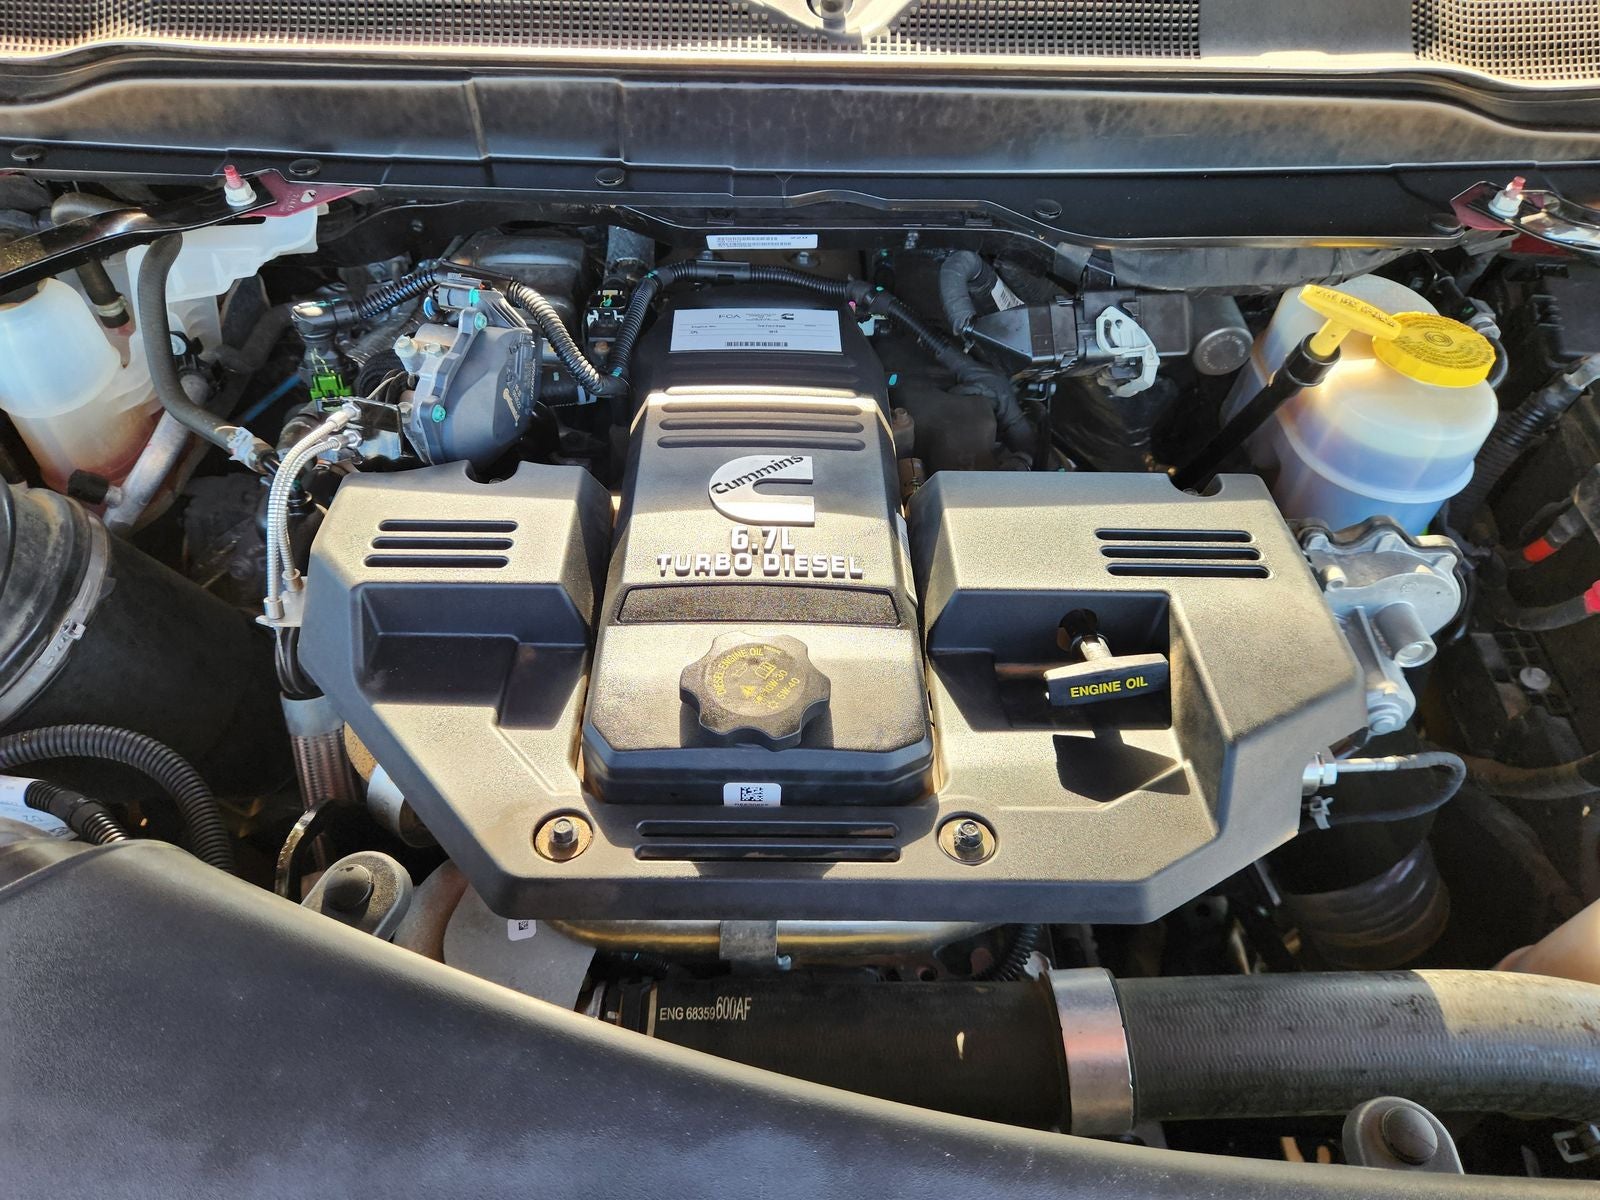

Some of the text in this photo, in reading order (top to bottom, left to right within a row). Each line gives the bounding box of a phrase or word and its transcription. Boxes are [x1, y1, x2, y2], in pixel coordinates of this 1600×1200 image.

[711, 455, 804, 495] Cummins
[731, 525, 796, 555] 6.7L
[657, 552, 864, 579] TURBO DIESEL
[749, 647, 764, 657] OIL
[777, 677, 800, 700] 5W-40
[1070, 676, 1149, 698] ENGINE OIL
[660, 1007, 684, 1021] ENG
